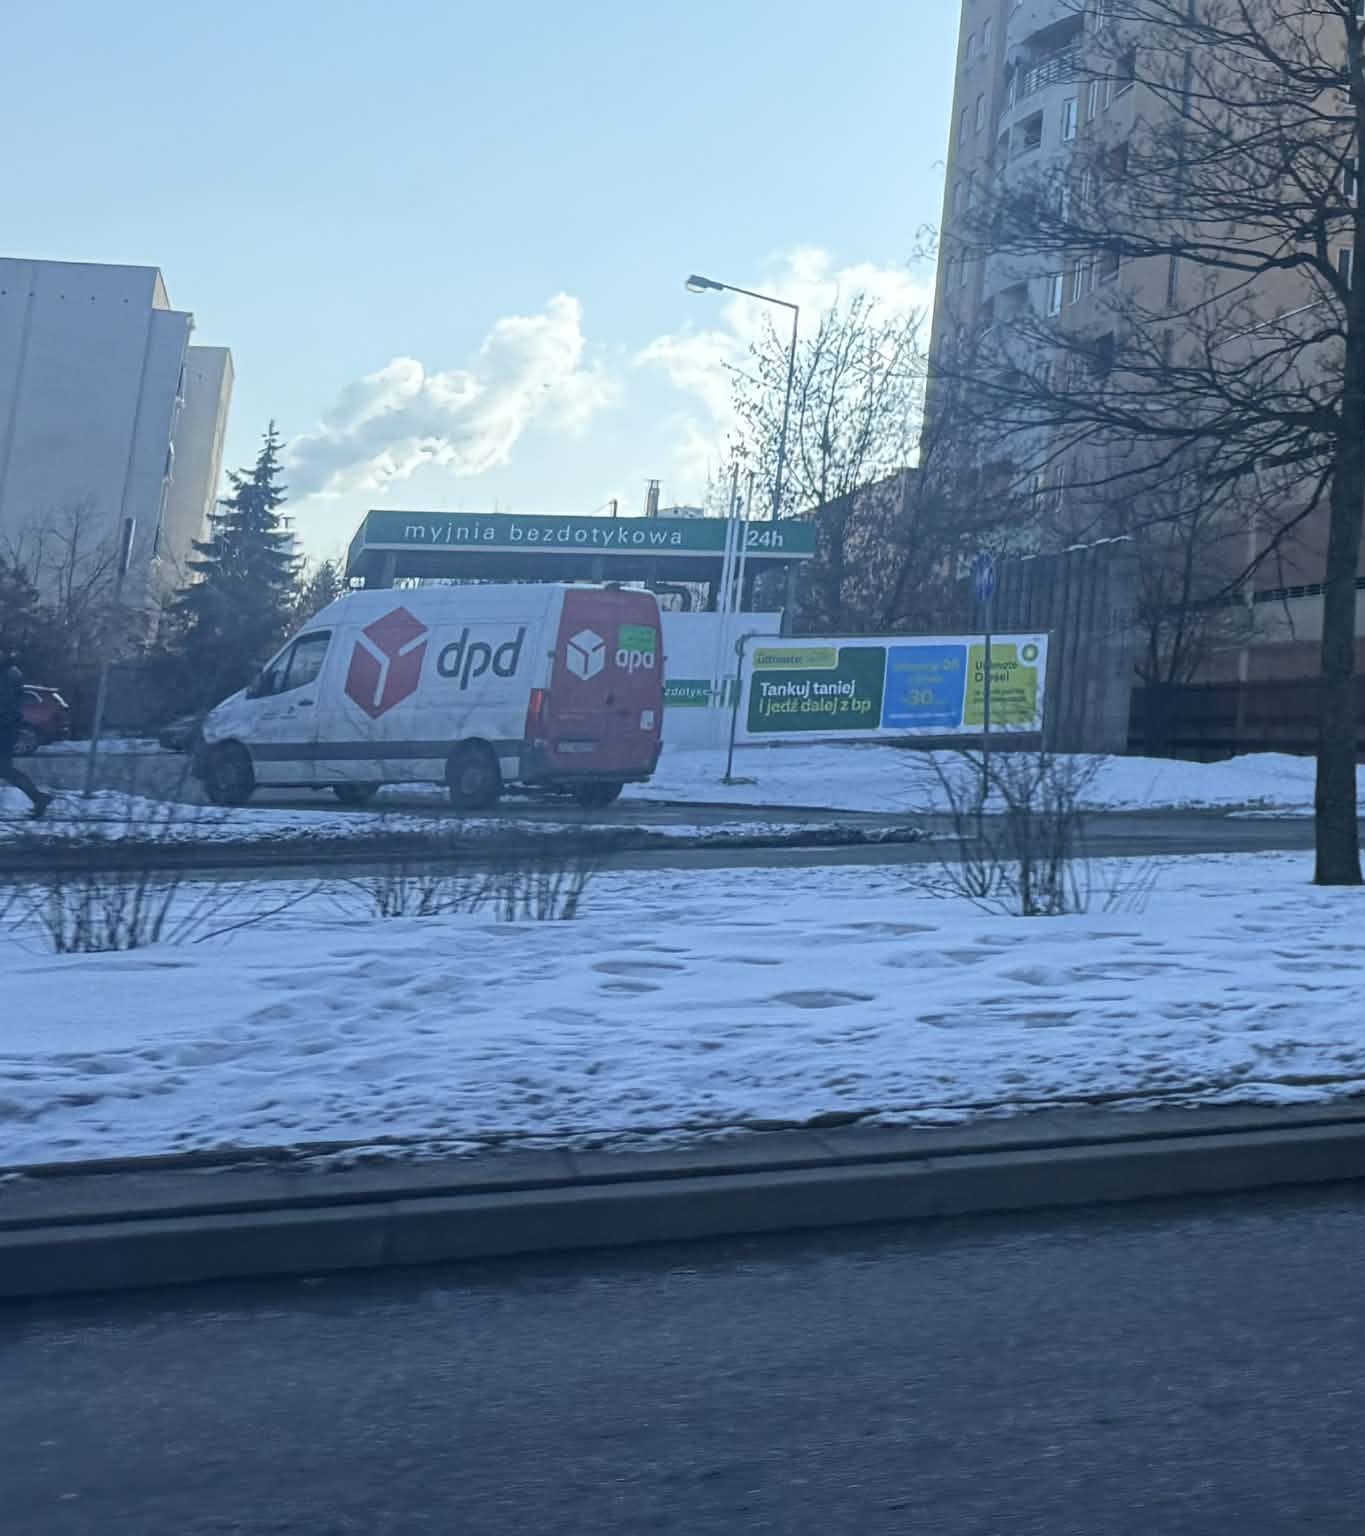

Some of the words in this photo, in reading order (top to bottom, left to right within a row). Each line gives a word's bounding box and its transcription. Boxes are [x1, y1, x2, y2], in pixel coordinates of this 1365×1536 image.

[404, 522, 495, 542] myjnia
[510, 524, 682, 545] bezdotykowa
[747, 530, 784, 546] 24h
[436, 627, 527, 690] dpd
[760, 680, 810, 698] Tankuj
[813, 680, 856, 697] taniej
[801, 697, 838, 715] dalej
[840, 699, 850, 712] z
[851, 697, 872, 714] bp
